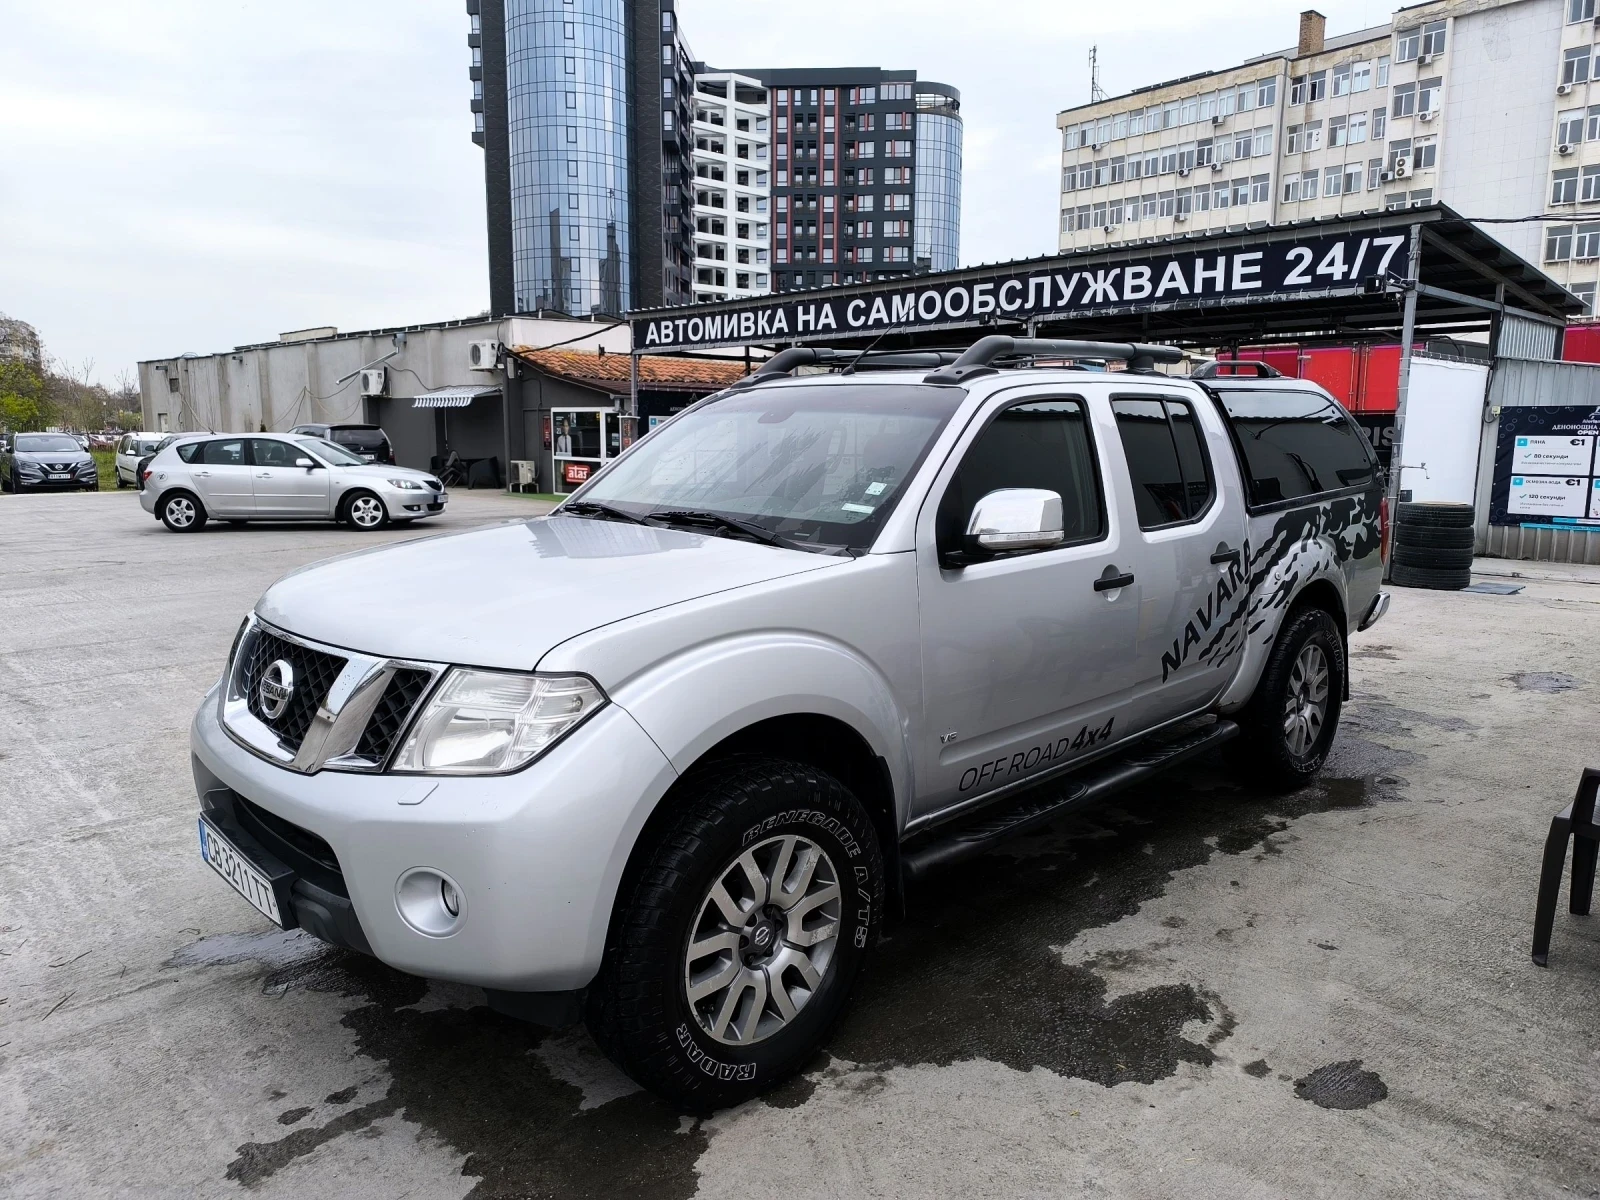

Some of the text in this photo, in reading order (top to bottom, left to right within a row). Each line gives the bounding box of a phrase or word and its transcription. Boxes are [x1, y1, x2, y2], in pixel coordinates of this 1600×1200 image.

[645, 234, 1405, 345] АВТОМИВКА НА САМООБСЛУЖВАНЕ 24/7
[1569, 438, 1586, 446] €1
[1565, 478, 1581, 486] €1
[958, 757, 1007, 792] OFF
[742, 808, 862, 859] RENEGADE
[676, 1022, 757, 1081] RADAR
